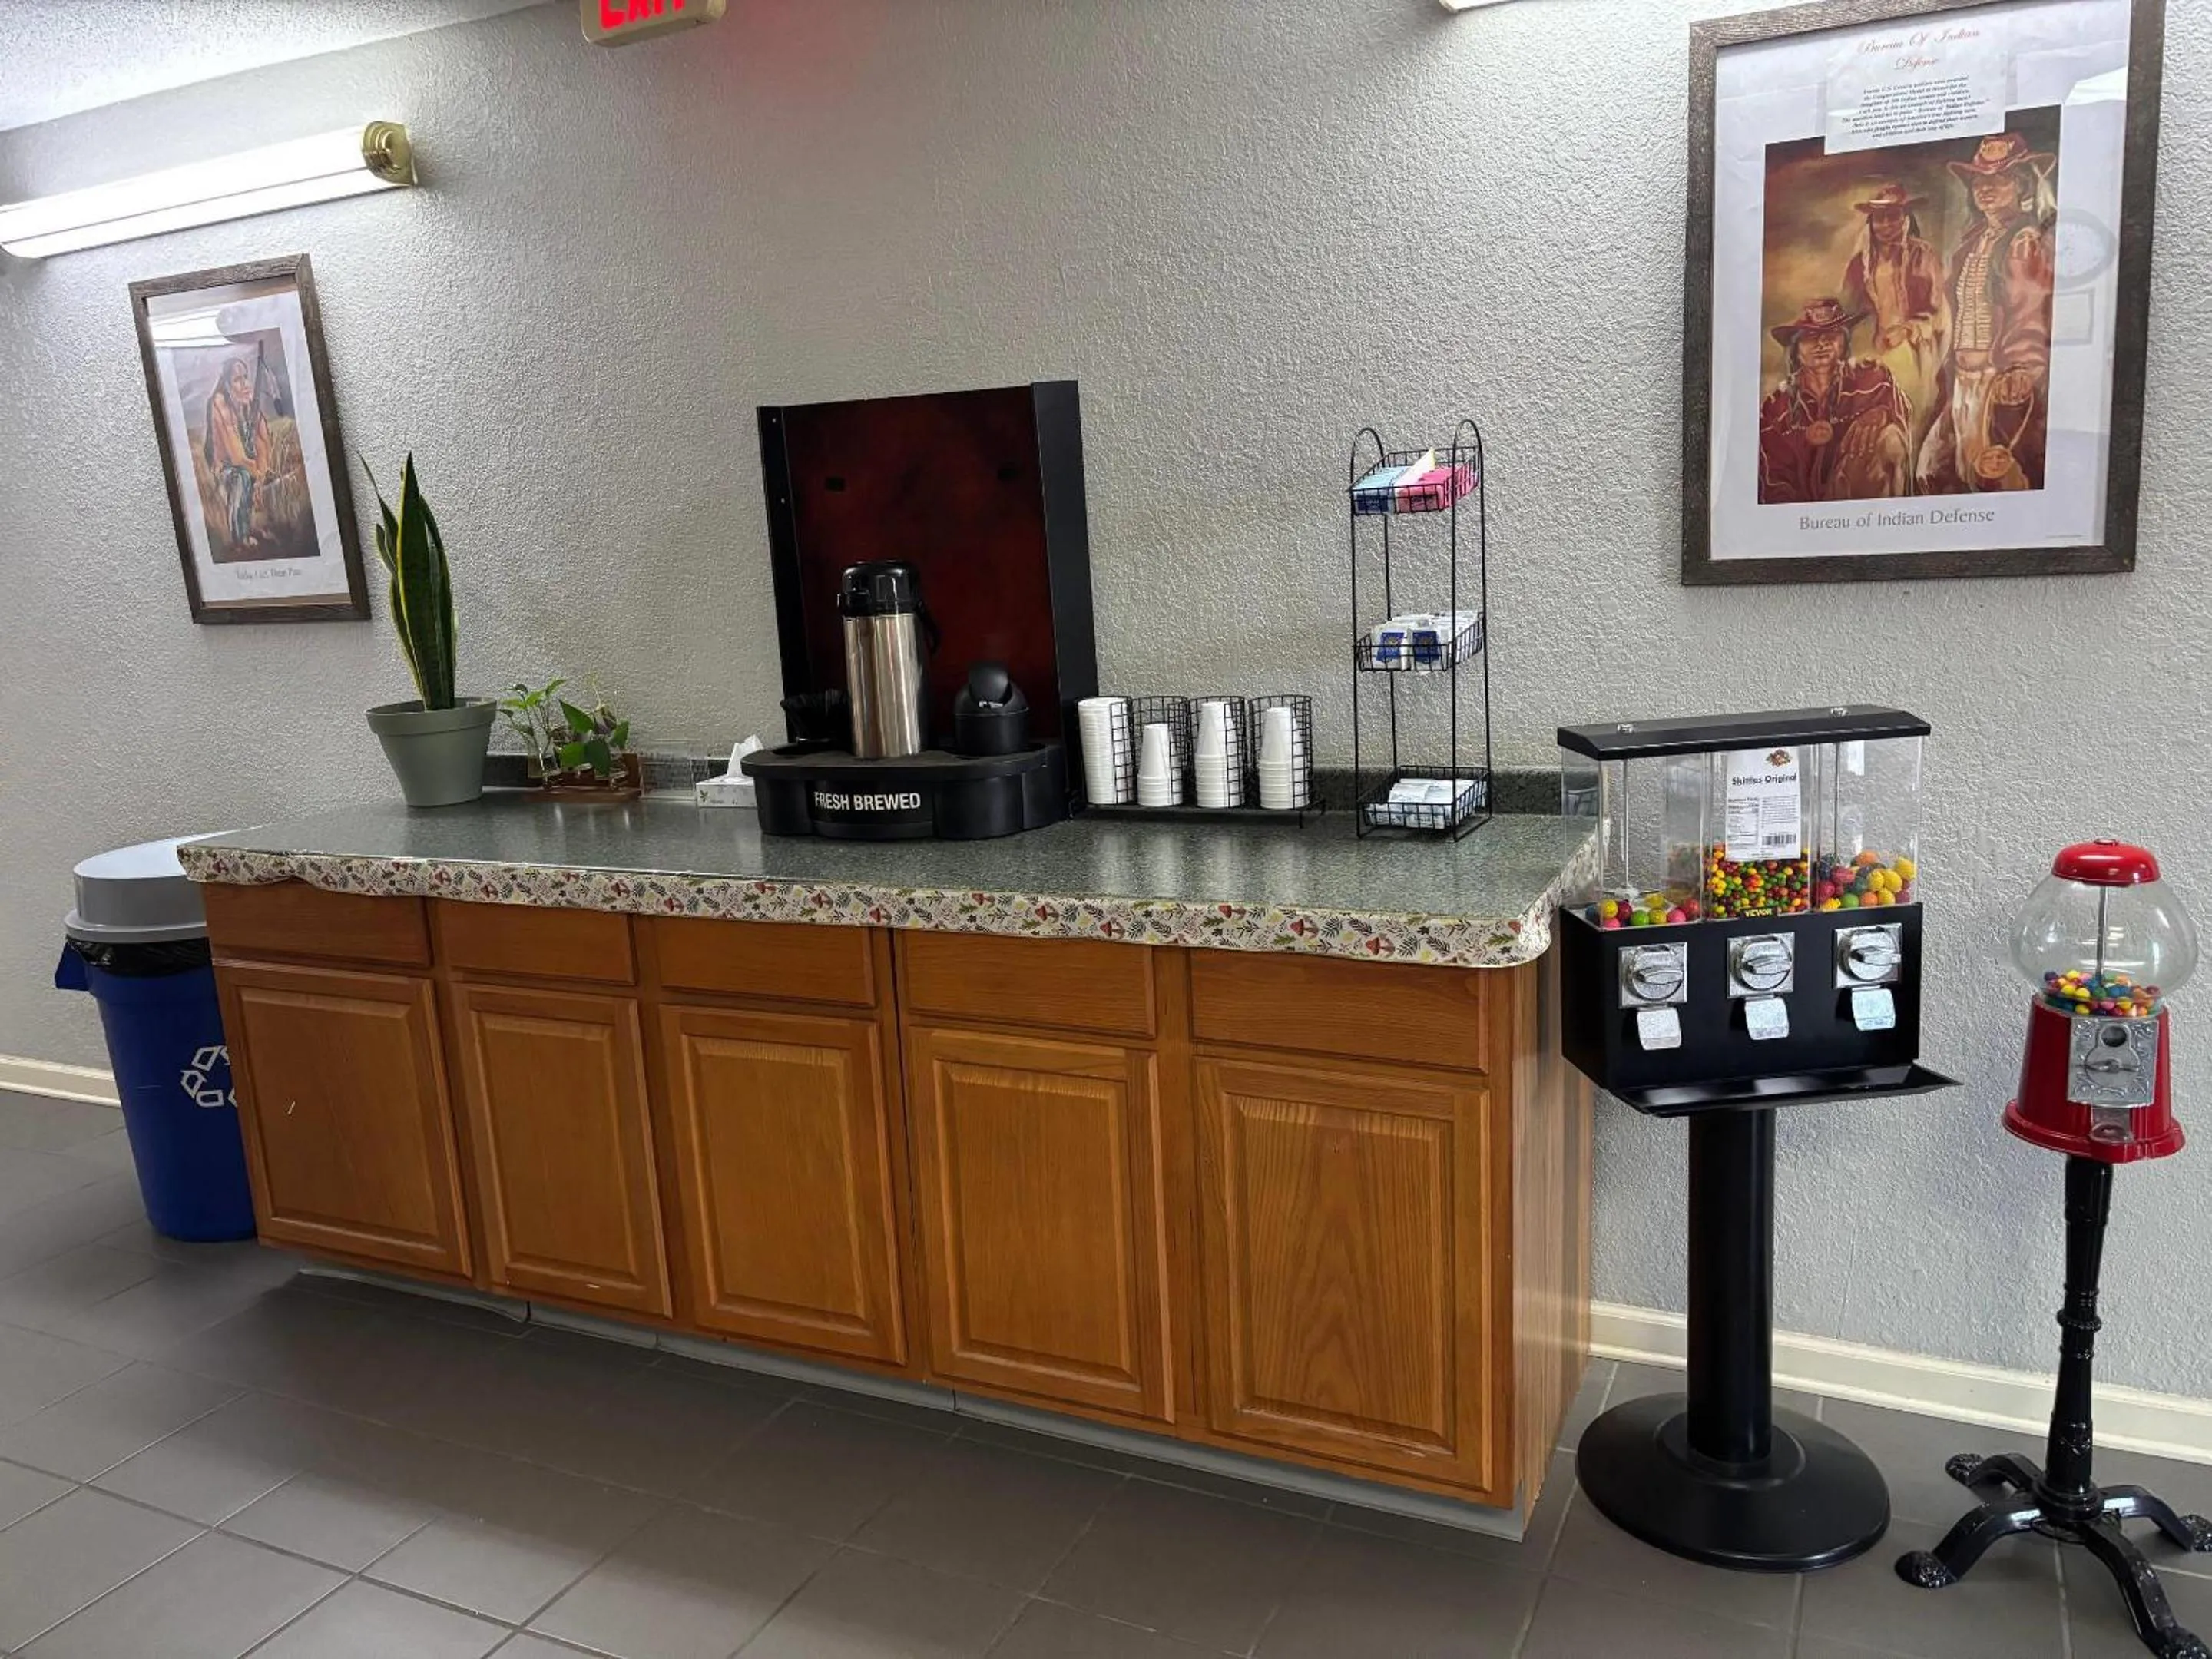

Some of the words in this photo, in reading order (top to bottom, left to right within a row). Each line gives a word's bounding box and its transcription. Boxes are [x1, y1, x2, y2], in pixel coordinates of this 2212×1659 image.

[1857, 38, 1903, 52] Bureau
[1800, 515, 1850, 530] Bureau
[1856, 512, 1872, 528] of
[1878, 512, 1924, 526] Indian
[1930, 508, 1995, 525] Defense
[1732, 776, 1762, 786] Skittles
[1765, 773, 1796, 784] Original
[813, 791, 850, 810] FRESH
[853, 793, 921, 810] BREWED
